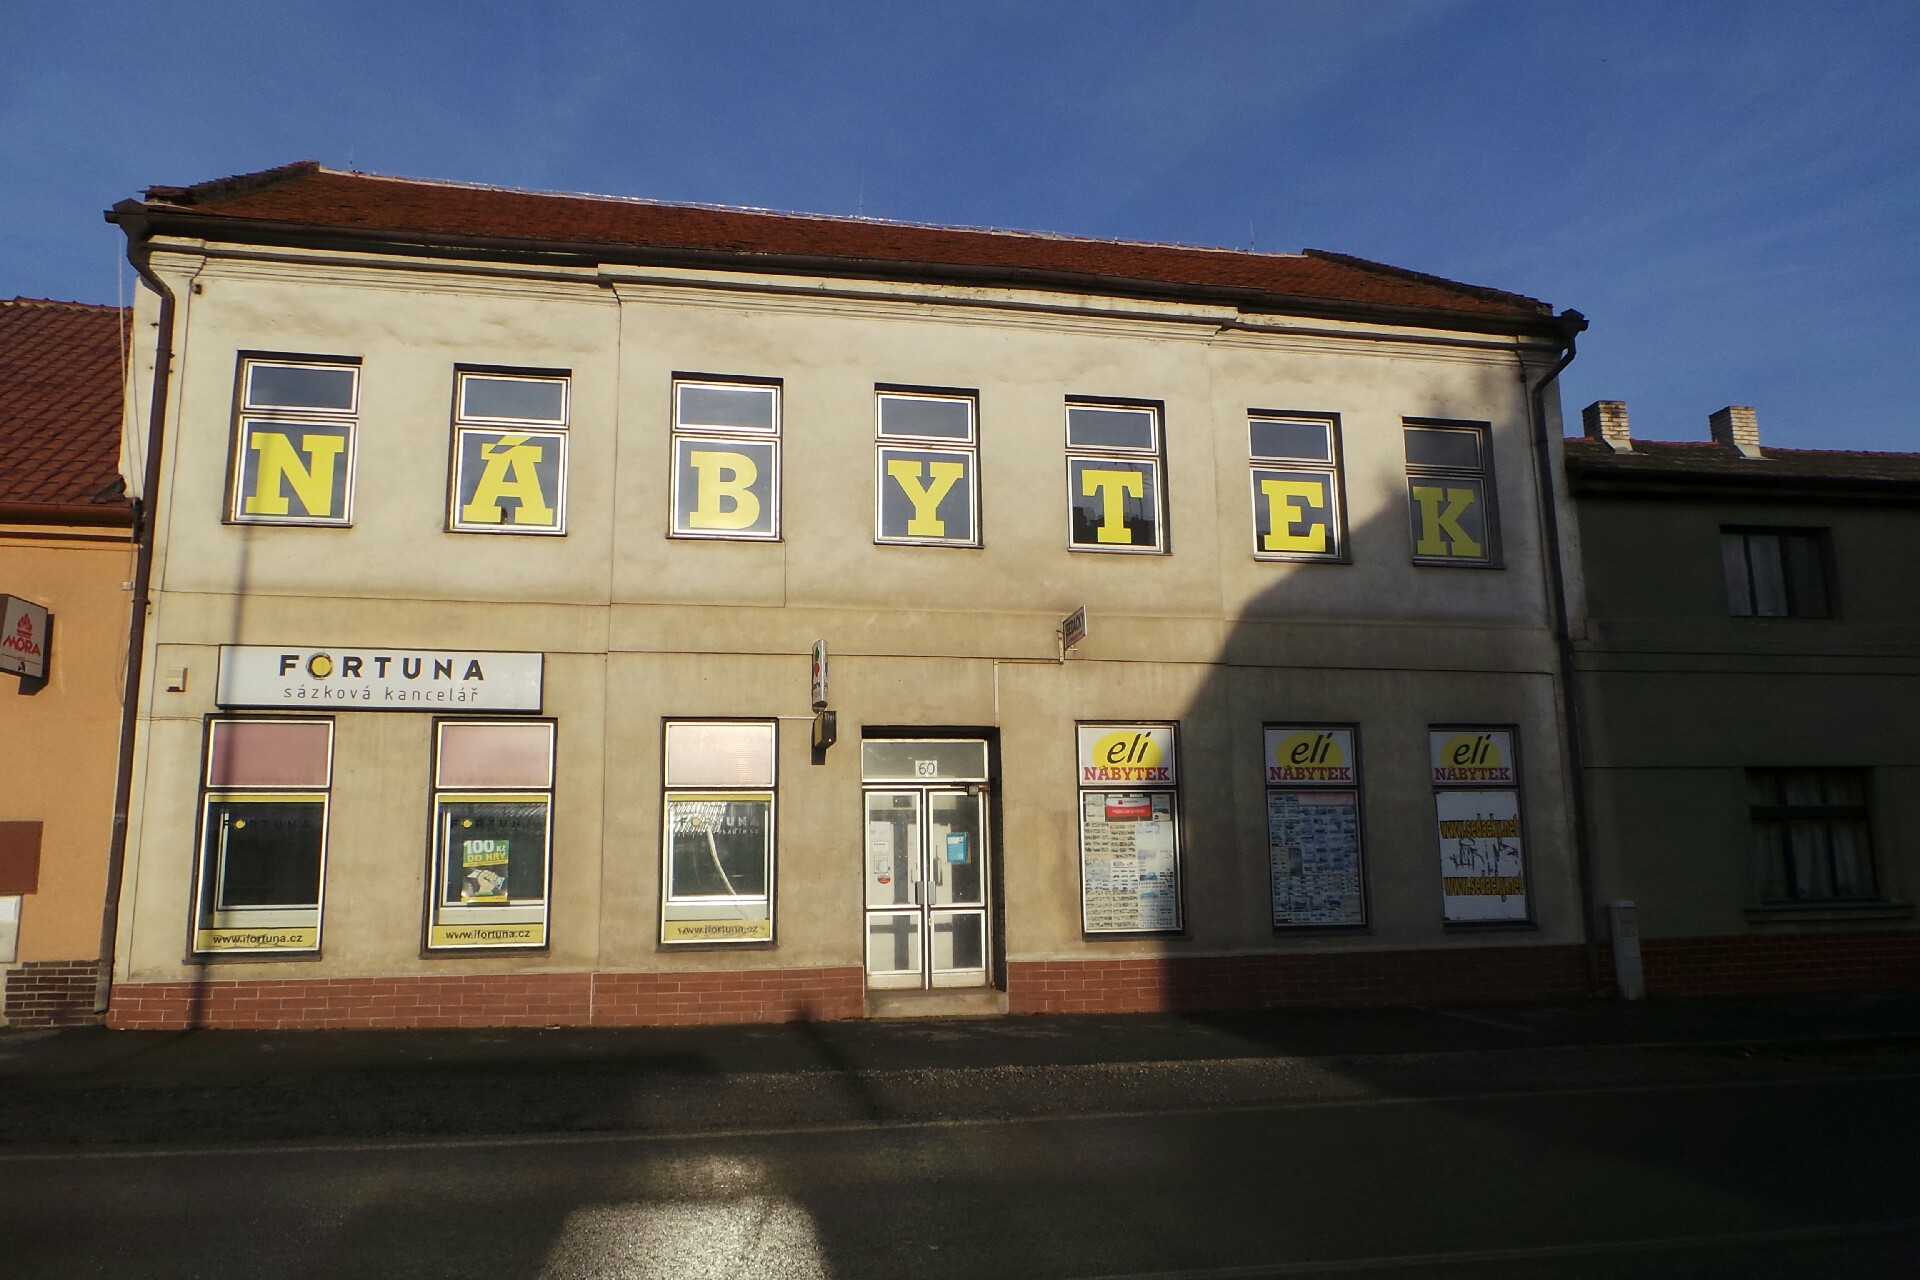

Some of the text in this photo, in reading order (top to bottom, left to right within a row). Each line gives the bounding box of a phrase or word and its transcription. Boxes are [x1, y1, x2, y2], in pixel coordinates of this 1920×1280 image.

[3, 635, 41, 656] MORA
[279, 652, 484, 681] FORTUNA
[284, 685, 479, 702] sázková kancelář
[1106, 731, 1152, 764] eli
[1290, 732, 1333, 765] eli
[1452, 734, 1492, 766] eli
[918, 762, 936, 776] 60
[1084, 765, 1170, 781] NÁBYTEK
[1269, 765, 1351, 781] NÁBYTEK
[1434, 766, 1511, 781] NÁBYTEK
[463, 840, 495, 855] 100
[467, 851, 506, 863] DO HRY
[445, 928, 531, 940] www.ifortuna.cz
[677, 924, 759, 935] www.ifortuna.cz
[212, 933, 303, 944] www.ifortuna.cz
